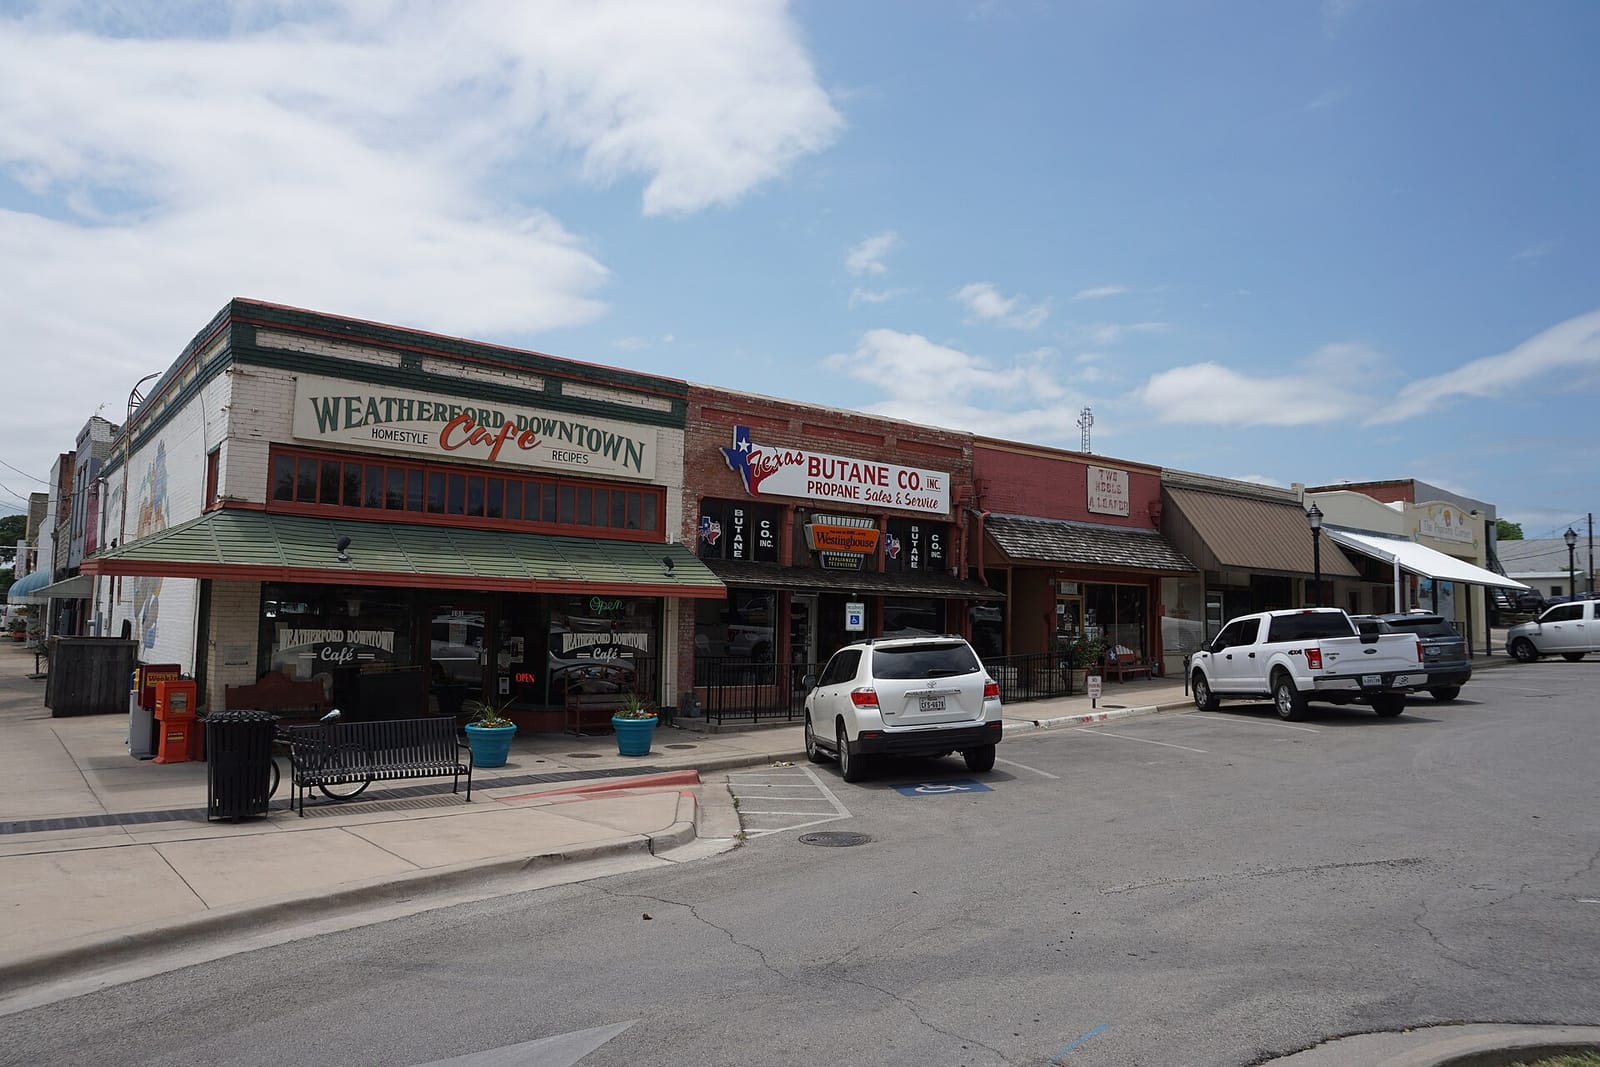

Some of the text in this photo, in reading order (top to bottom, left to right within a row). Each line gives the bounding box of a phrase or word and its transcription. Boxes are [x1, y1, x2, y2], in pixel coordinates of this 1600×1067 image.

[309, 396, 647, 474] WEATHERFORD DOWNTOWN
[371, 427, 429, 446] HOMESTYLE
[439, 414, 542, 462] Cafe
[552, 449, 589, 465] RECIPES
[746, 449, 805, 477] Texas
[807, 456, 941, 492] BUTANE CO. INC.
[807, 480, 939, 510] PROPANE Sales & Service
[733, 508, 744, 558] BUTANE
[816, 531, 875, 550] Westinghouse
[910, 525, 919, 569] BUTANE
[589, 596, 625, 615] Open
[279, 629, 395, 654] WEATHERFORD DOWNTOWN
[562, 633, 648, 654] WEATHERFORD DOWNTOWN
[320, 647, 354, 665] Café
[592, 647, 619, 663] Café
[514, 672, 536, 684] OPEN
